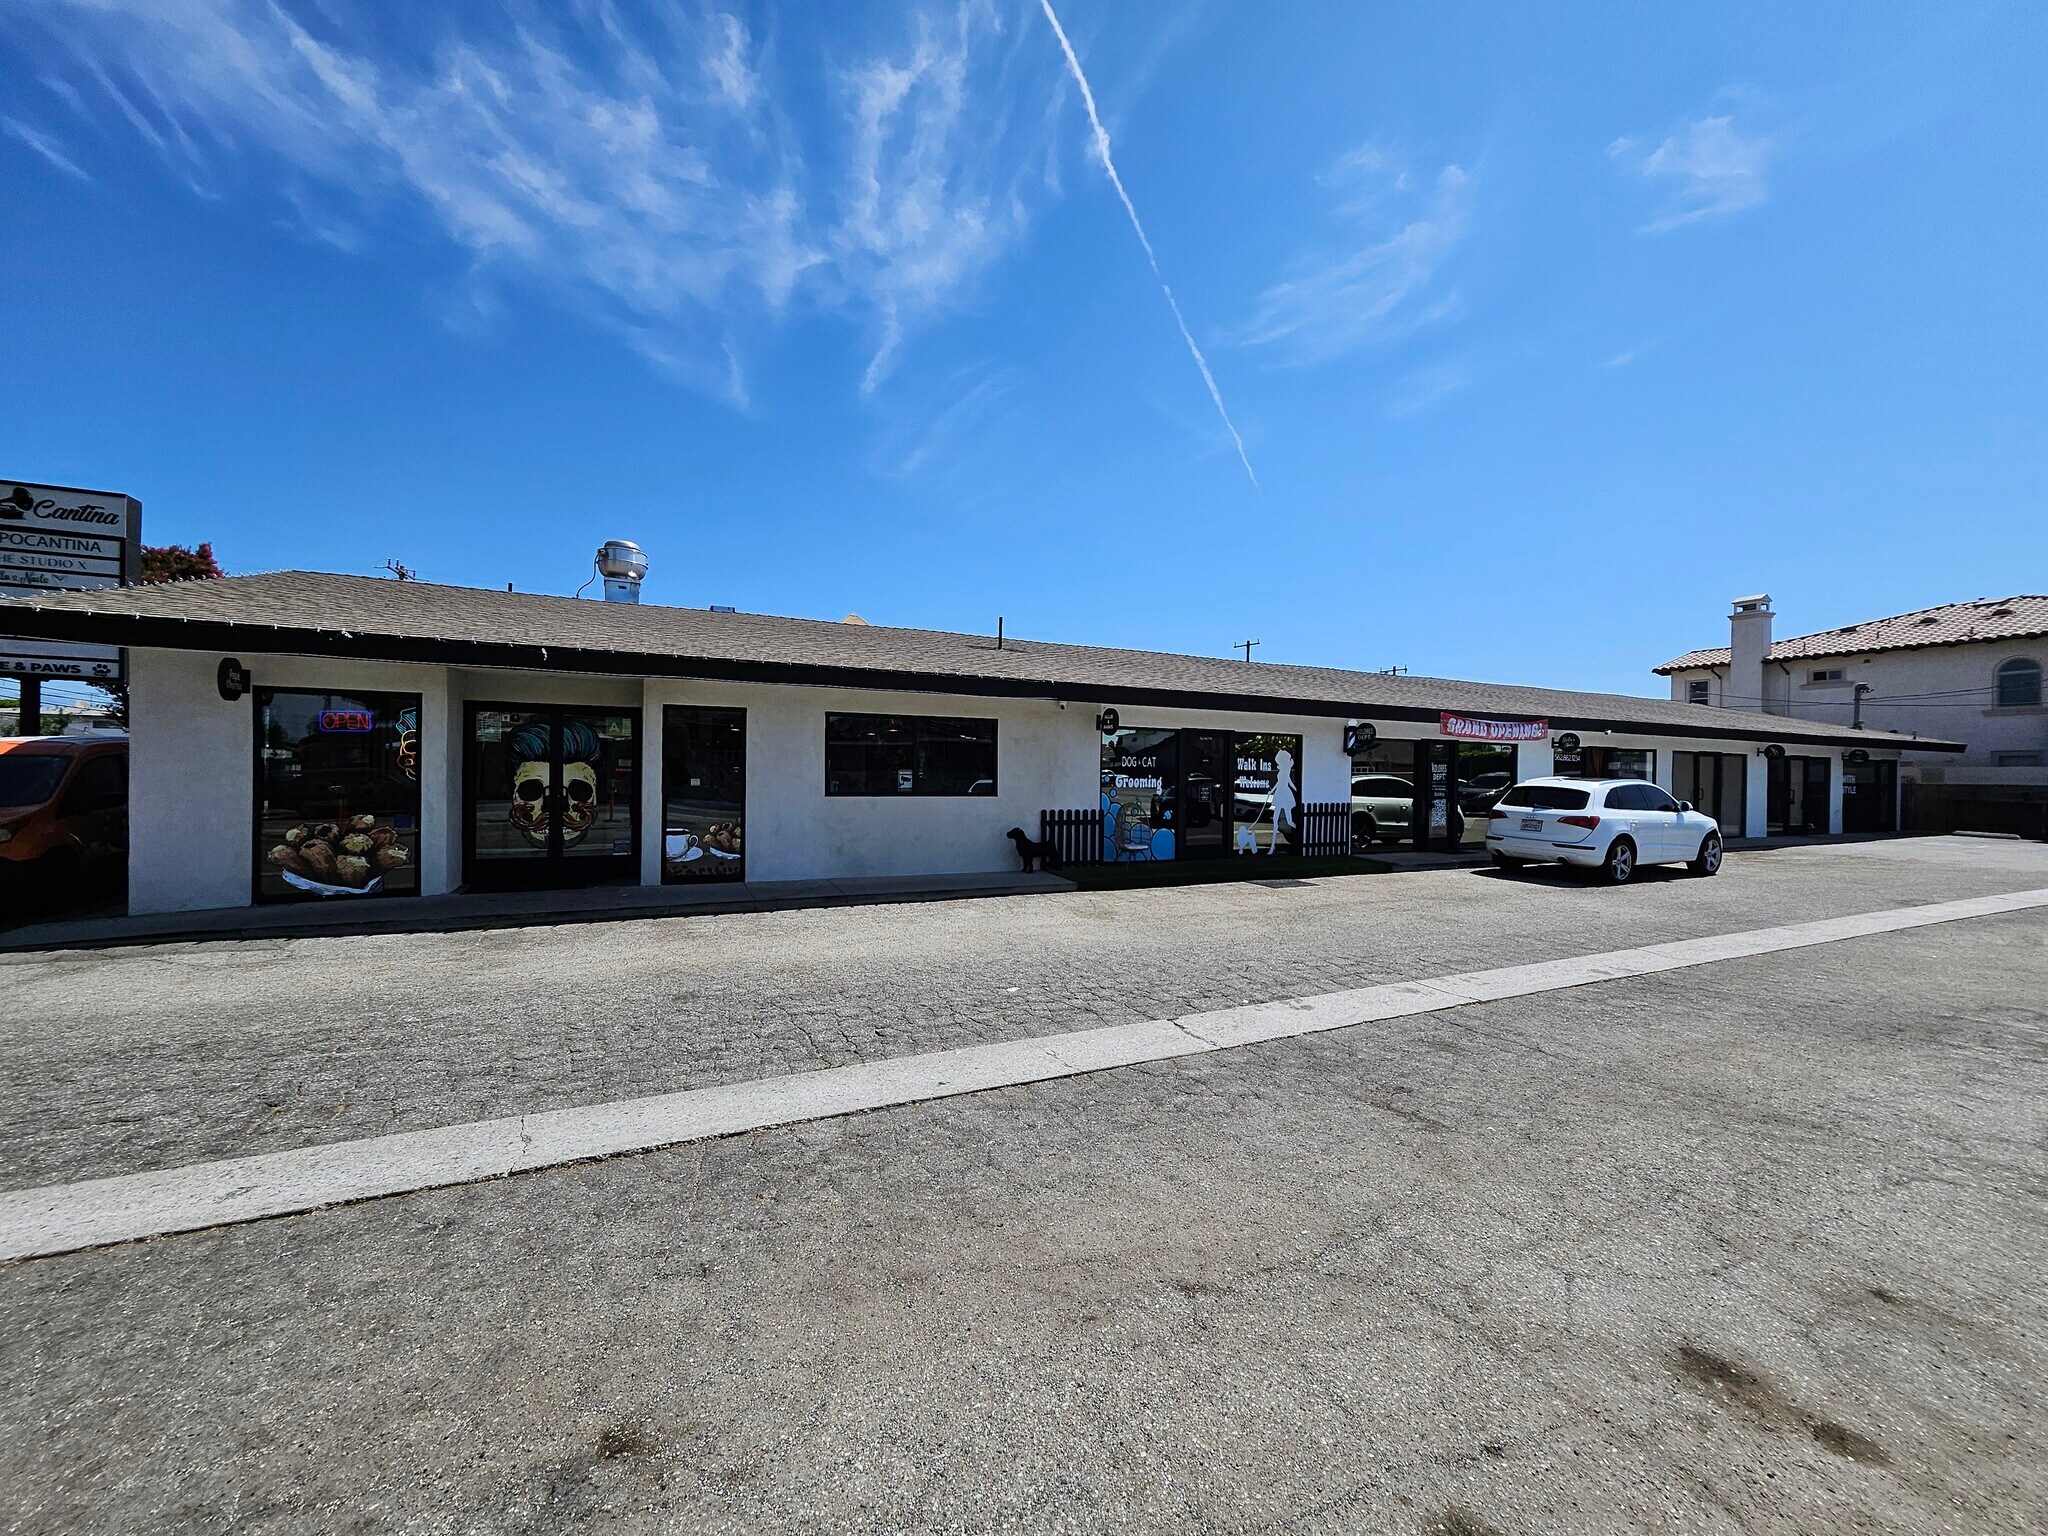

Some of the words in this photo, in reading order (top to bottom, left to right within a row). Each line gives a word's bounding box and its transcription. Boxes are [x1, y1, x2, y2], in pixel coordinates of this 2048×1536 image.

[33, 499, 120, 526] Cantina
[20, 556, 74, 569] STUDIO
[78, 560, 87, 570] X
[14, 661, 26, 671] &
[30, 662, 82, 674] PAWS
[322, 712, 369, 730] OPEN
[1446, 717, 1488, 737] GRAND
[1121, 755, 1137, 767] DOG
[1141, 756, 1157, 768] CAT
[1236, 757, 1257, 771] Walk
[1259, 758, 1272, 772] Ins
[1115, 774, 1163, 796] Grooming
